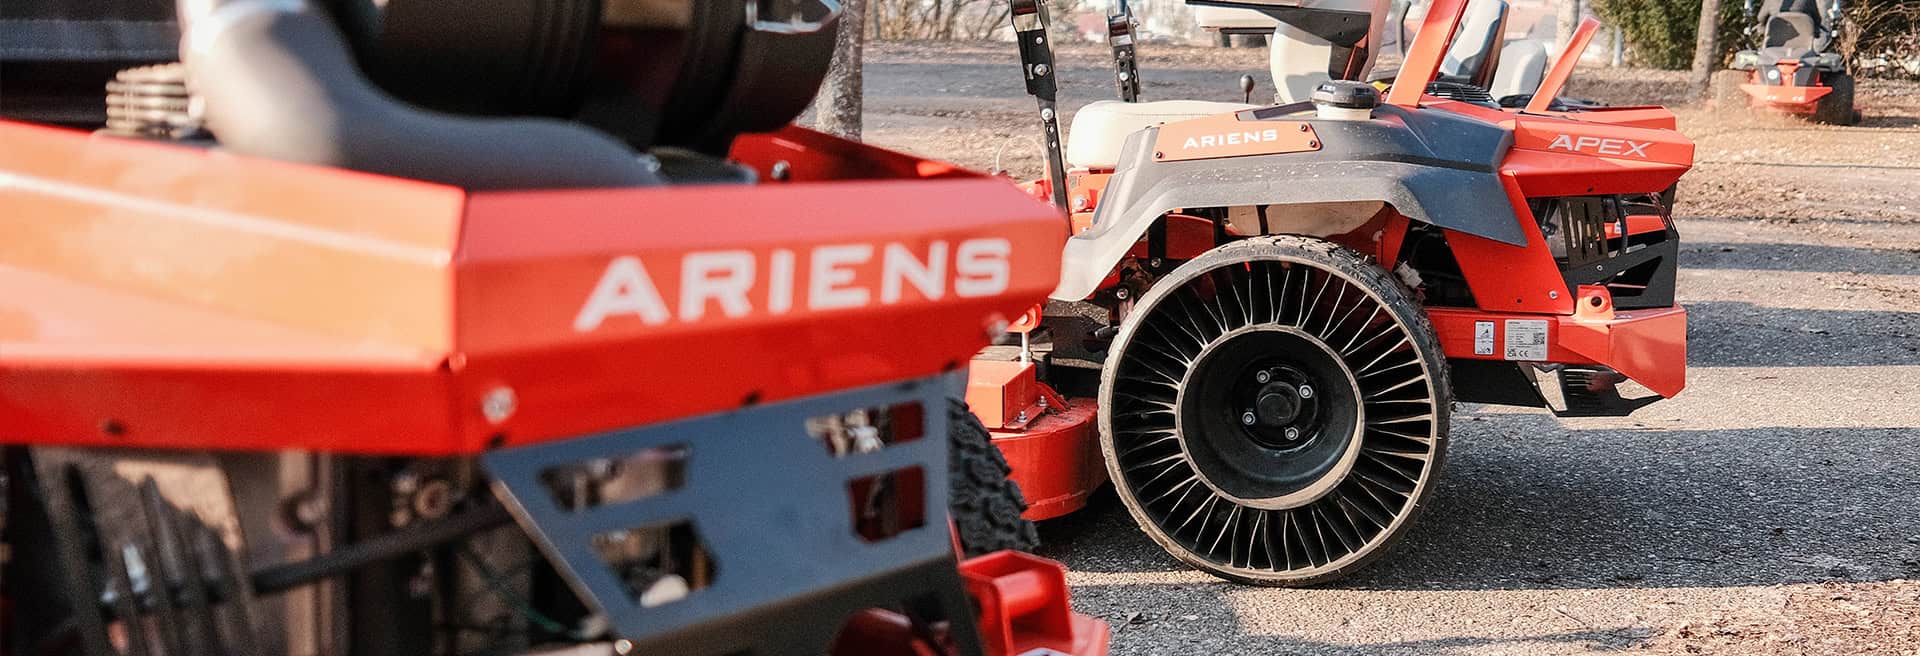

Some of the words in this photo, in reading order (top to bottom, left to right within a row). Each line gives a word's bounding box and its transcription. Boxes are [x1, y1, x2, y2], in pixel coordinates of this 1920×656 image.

[1183, 129, 1278, 149] ARIENS
[1547, 134, 1652, 157] APEX
[574, 238, 1010, 331] ARIENS
